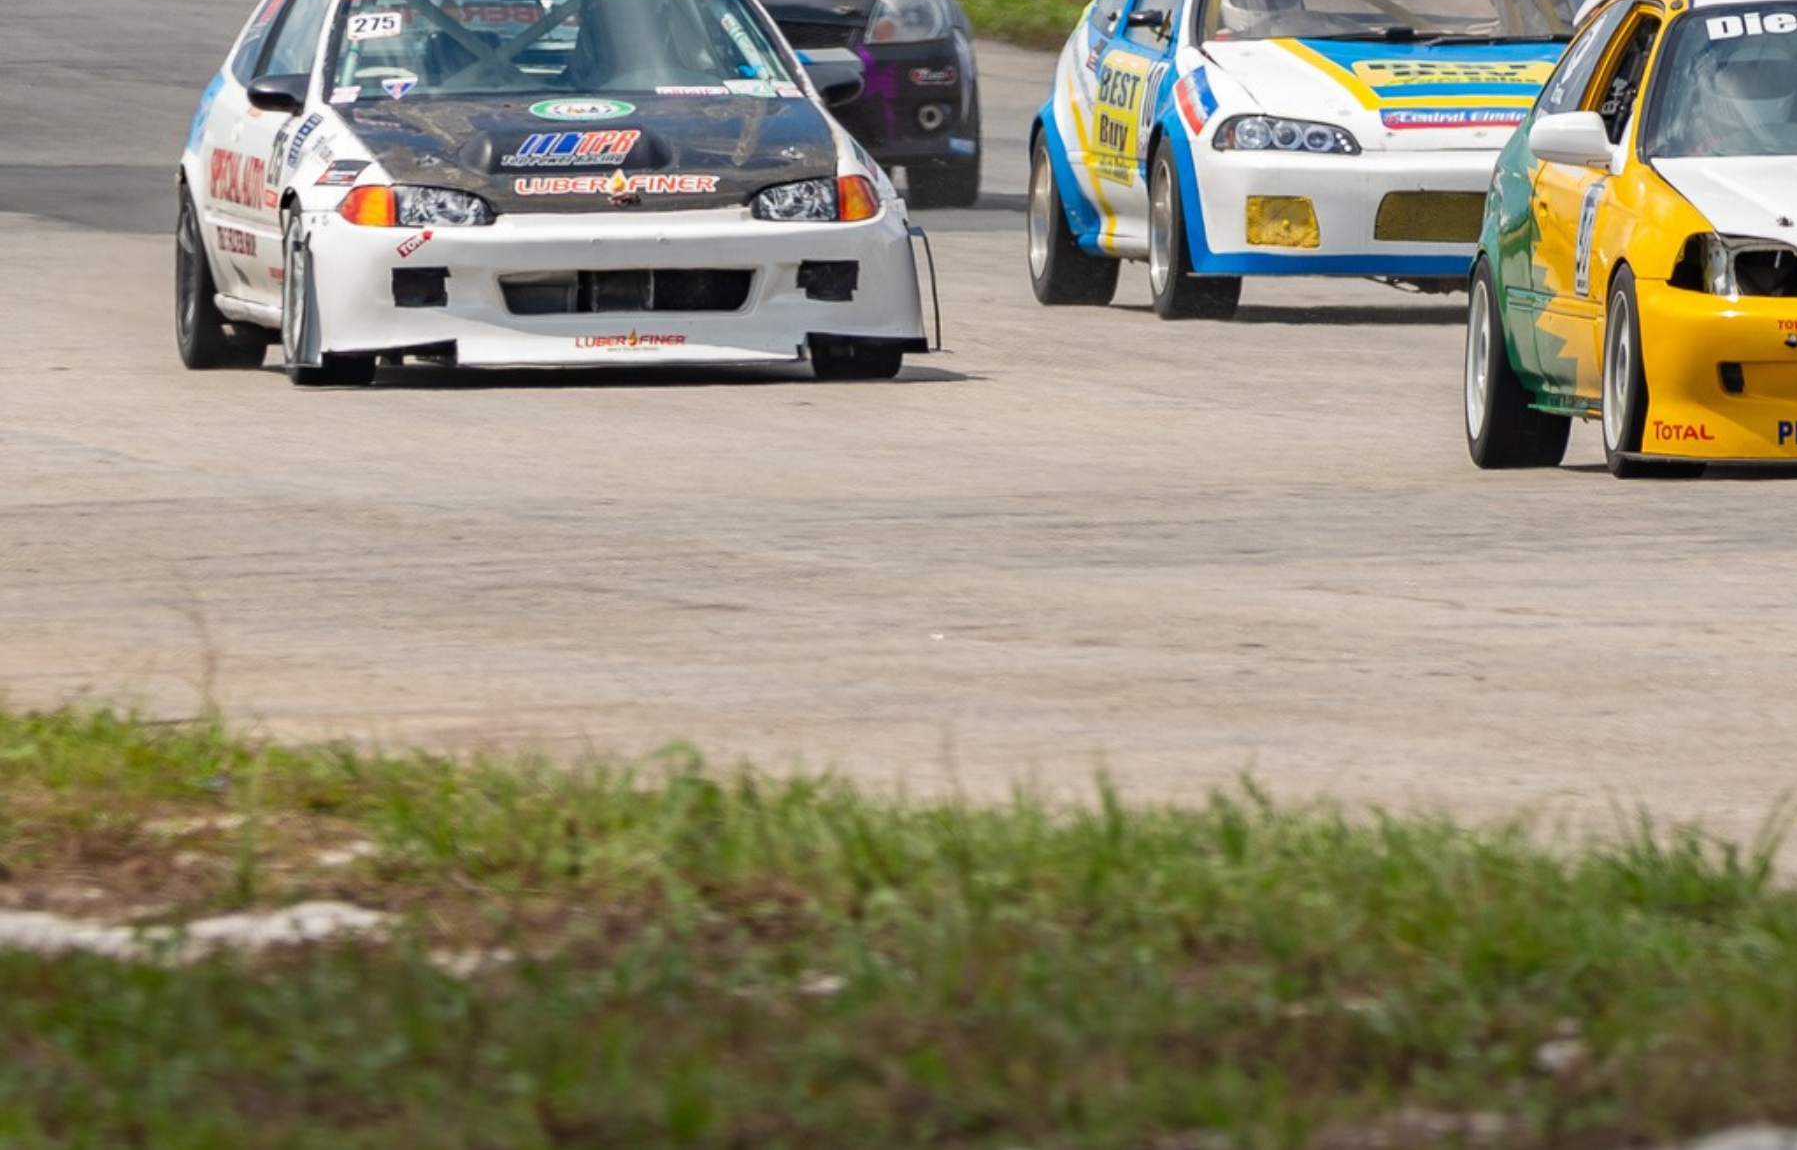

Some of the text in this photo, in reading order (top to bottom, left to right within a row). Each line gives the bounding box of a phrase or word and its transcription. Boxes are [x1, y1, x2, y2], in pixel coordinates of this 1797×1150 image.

[353, 16, 395, 34] 275
[1099, 65, 1141, 111] BEST
[576, 130, 641, 155] TPR
[514, 175, 720, 196] LUBER FINER
[639, 334, 686, 346] FINER
[1653, 421, 1715, 440] TOTAL
